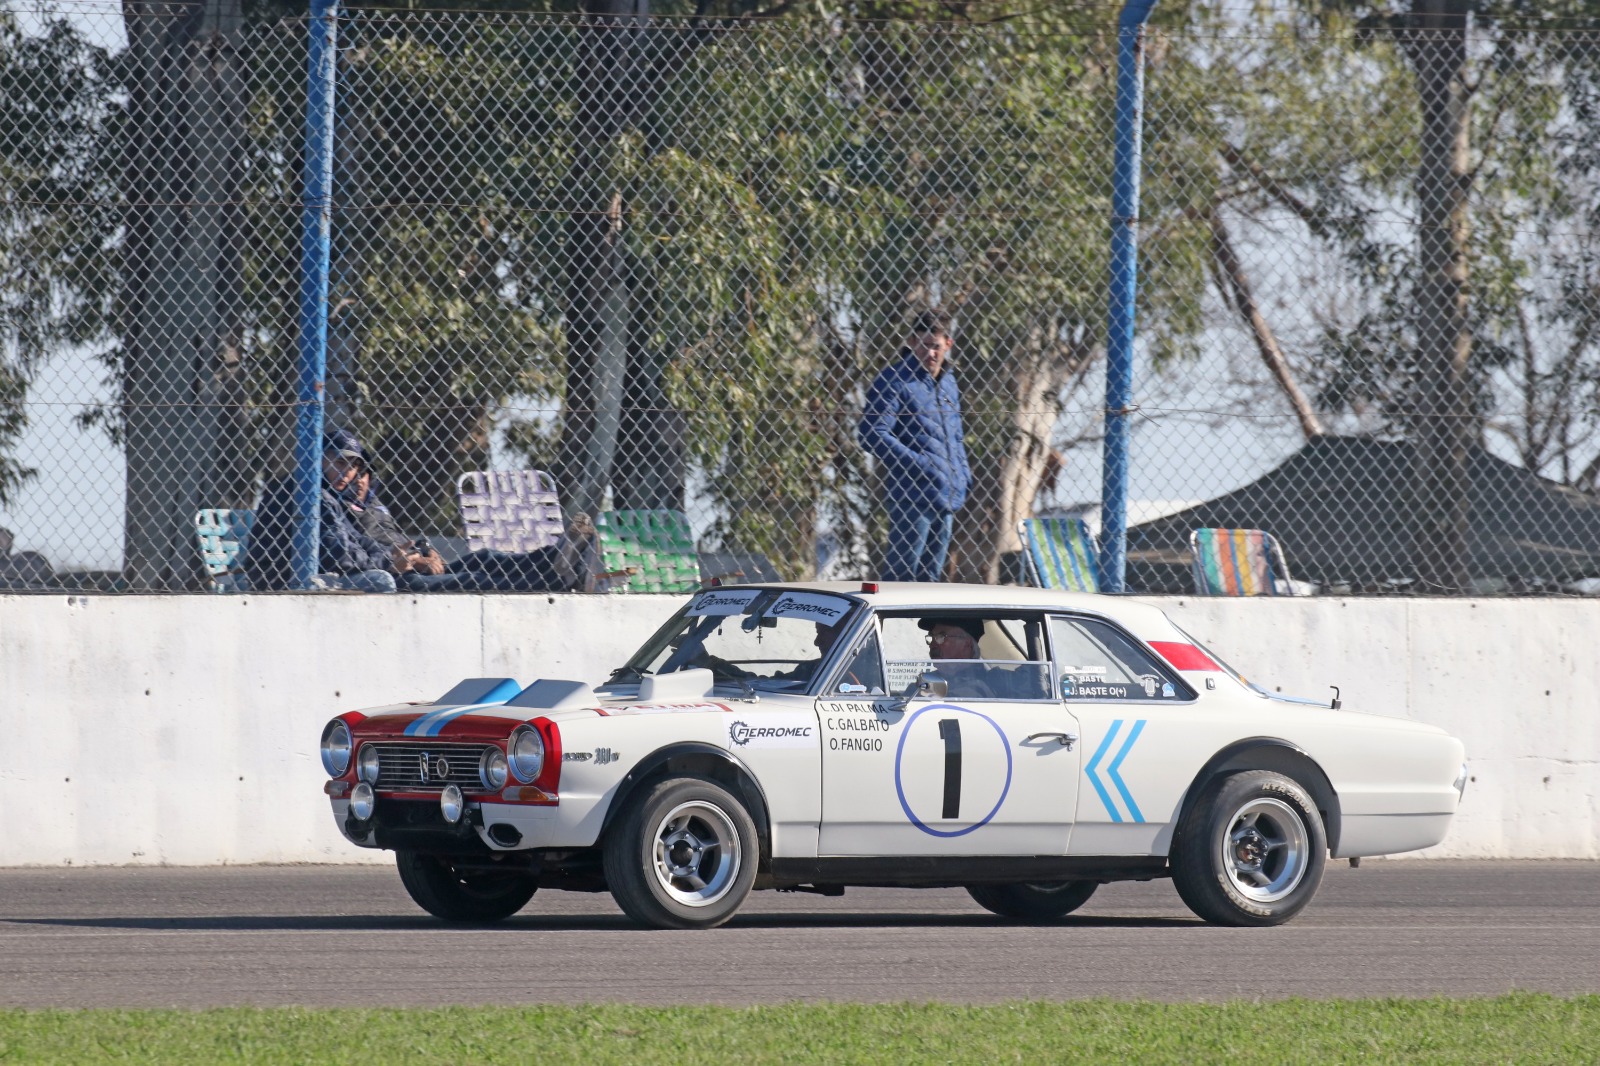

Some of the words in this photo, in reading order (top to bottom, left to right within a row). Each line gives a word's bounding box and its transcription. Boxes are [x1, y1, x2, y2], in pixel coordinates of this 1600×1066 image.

[779, 601, 841, 618] FIERROMEC
[1079, 675, 1107, 683] BASTE
[1079, 687, 1108, 696] BASTE
[1109, 687, 1127, 697] O(+)
[846, 703, 889, 714] PALMA
[827, 718, 890, 732] C.GALBATO
[737, 727, 812, 738] FIERROMEC
[829, 737, 883, 752] O.FANGIO
[938, 718, 962, 819] 1
